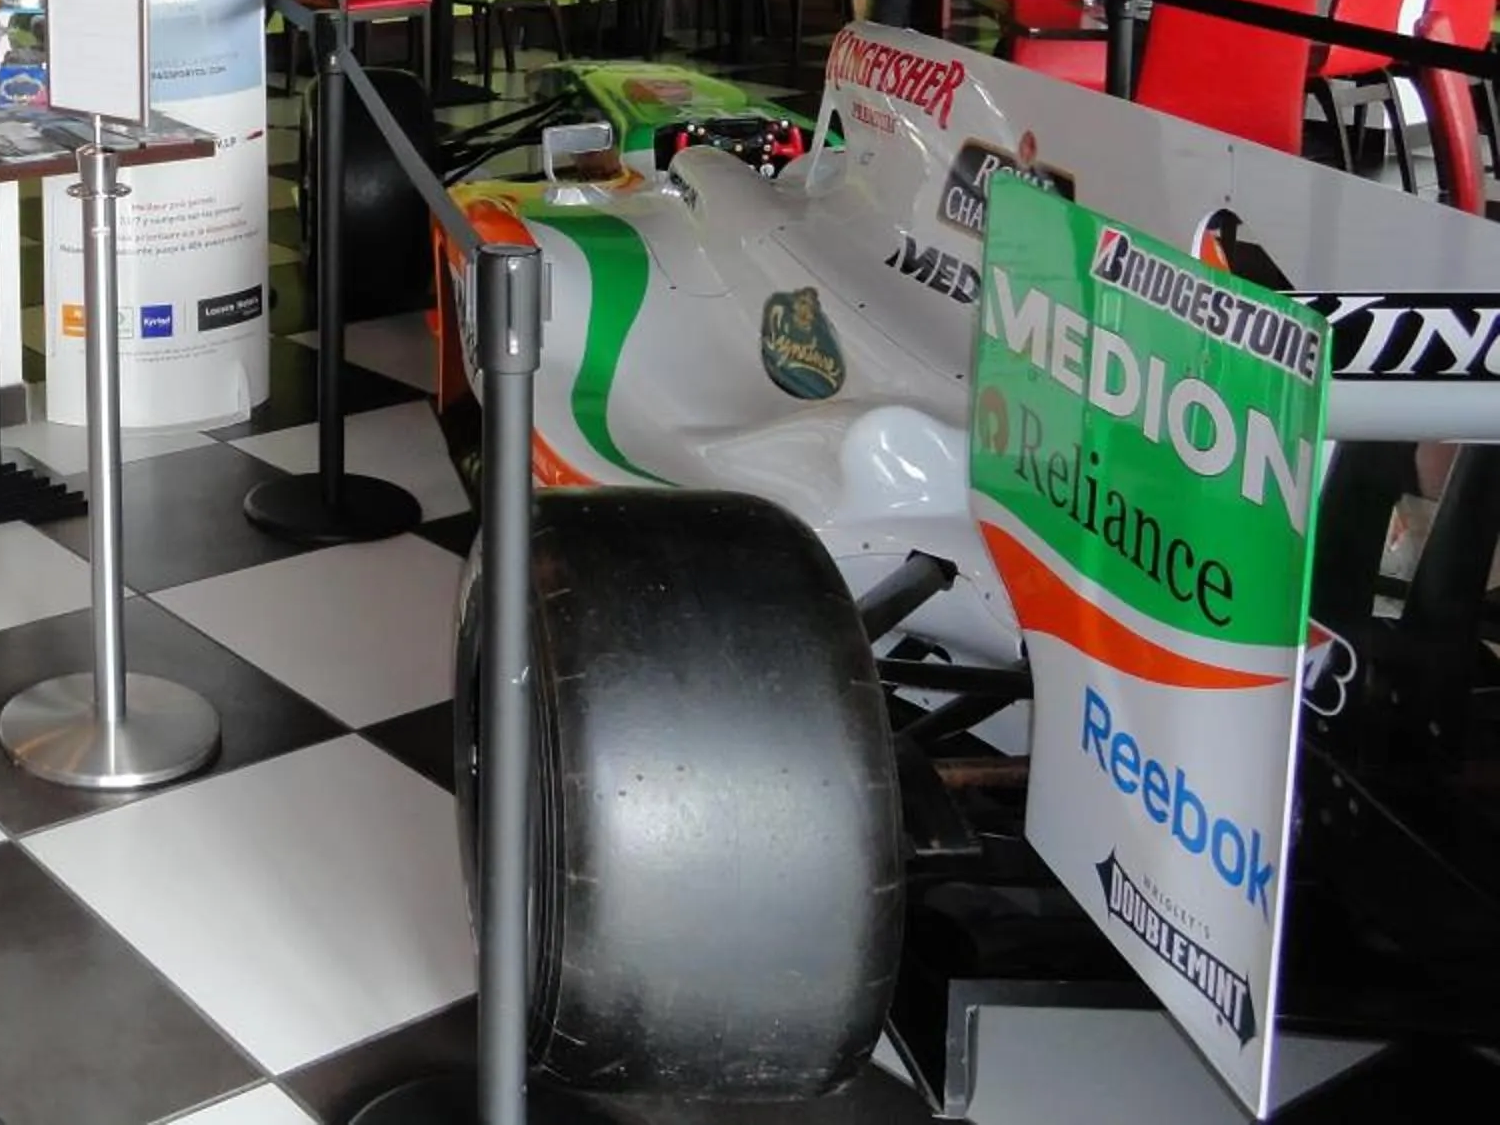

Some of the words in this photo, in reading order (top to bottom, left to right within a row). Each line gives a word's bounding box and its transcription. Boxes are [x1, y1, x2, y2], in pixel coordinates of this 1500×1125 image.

[826, 30, 965, 129] KINGFISHER
[984, 265, 1314, 538] MEDION
[1093, 229, 1321, 380] BRIDGESTONE
[1014, 404, 1234, 628] Reliance
[1081, 684, 1277, 928] Reebok
[1109, 860, 1248, 1032] DOUBLEMINT
